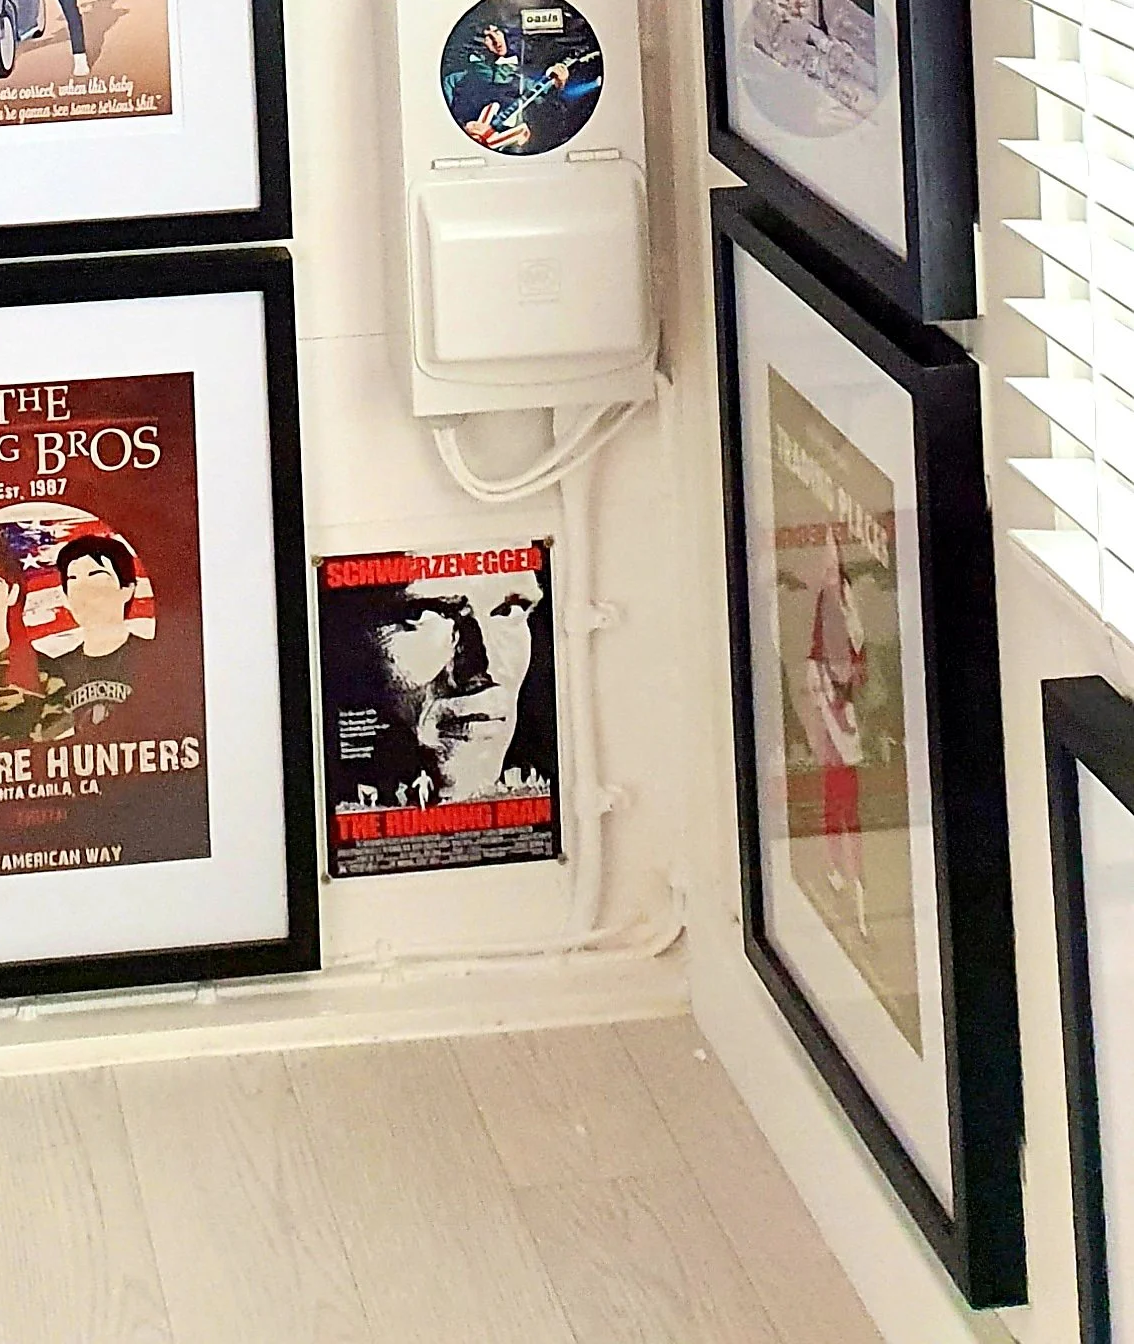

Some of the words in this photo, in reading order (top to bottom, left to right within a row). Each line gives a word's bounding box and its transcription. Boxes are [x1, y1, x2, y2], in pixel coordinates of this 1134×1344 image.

[526, 13, 558, 23] oasis
[30, 477, 66, 497] 1987
[327, 547, 543, 589] SCHWARZENEGGER
[47, 737, 200, 779] HUNTERS
[336, 813, 381, 841] THE
[385, 803, 493, 838] RUNNING
[497, 796, 552, 827] MAN
[1, 849, 81, 871] AMERICAN
[85, 845, 123, 865] WAY
